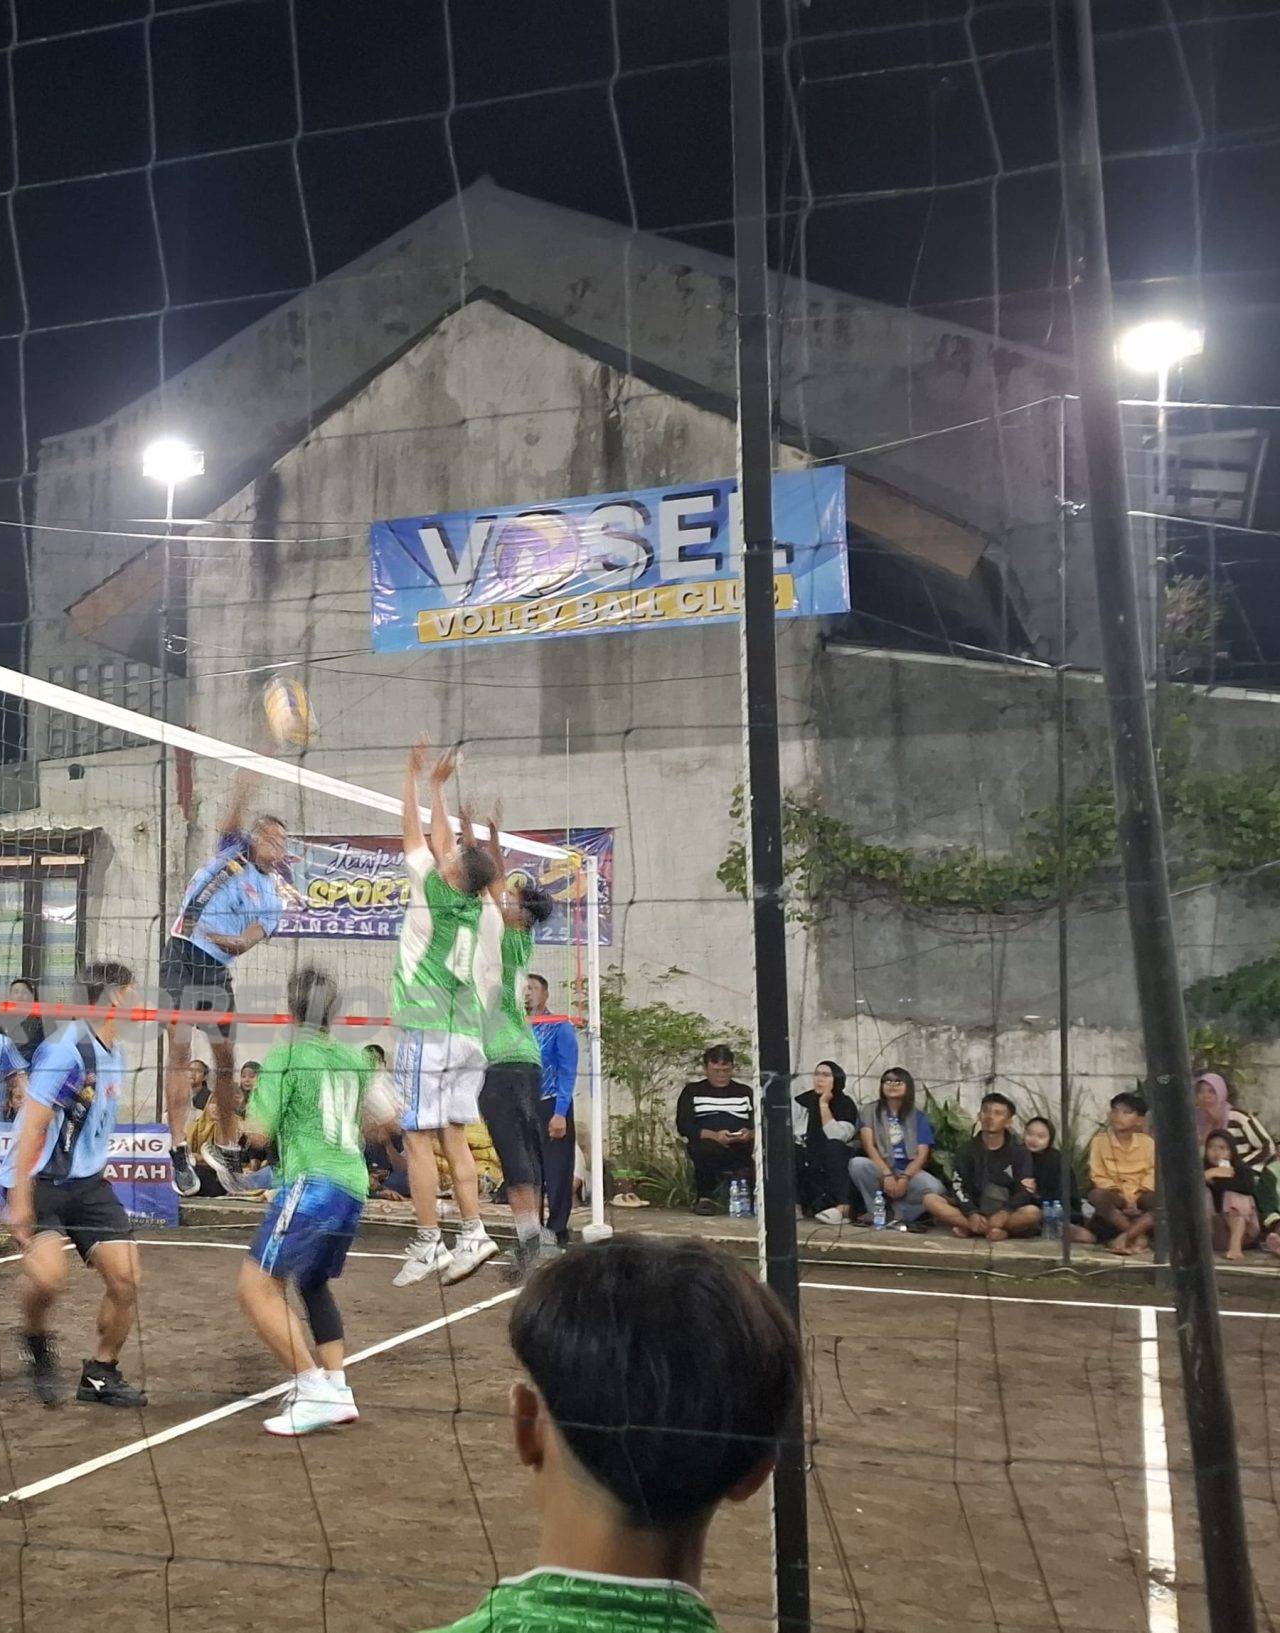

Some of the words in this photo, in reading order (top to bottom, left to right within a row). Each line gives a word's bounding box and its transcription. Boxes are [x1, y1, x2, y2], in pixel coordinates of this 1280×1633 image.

[434, 602, 563, 638] VOLLEY
[578, 590, 665, 624] BALL
[103, 1164, 166, 1179] ATAH
